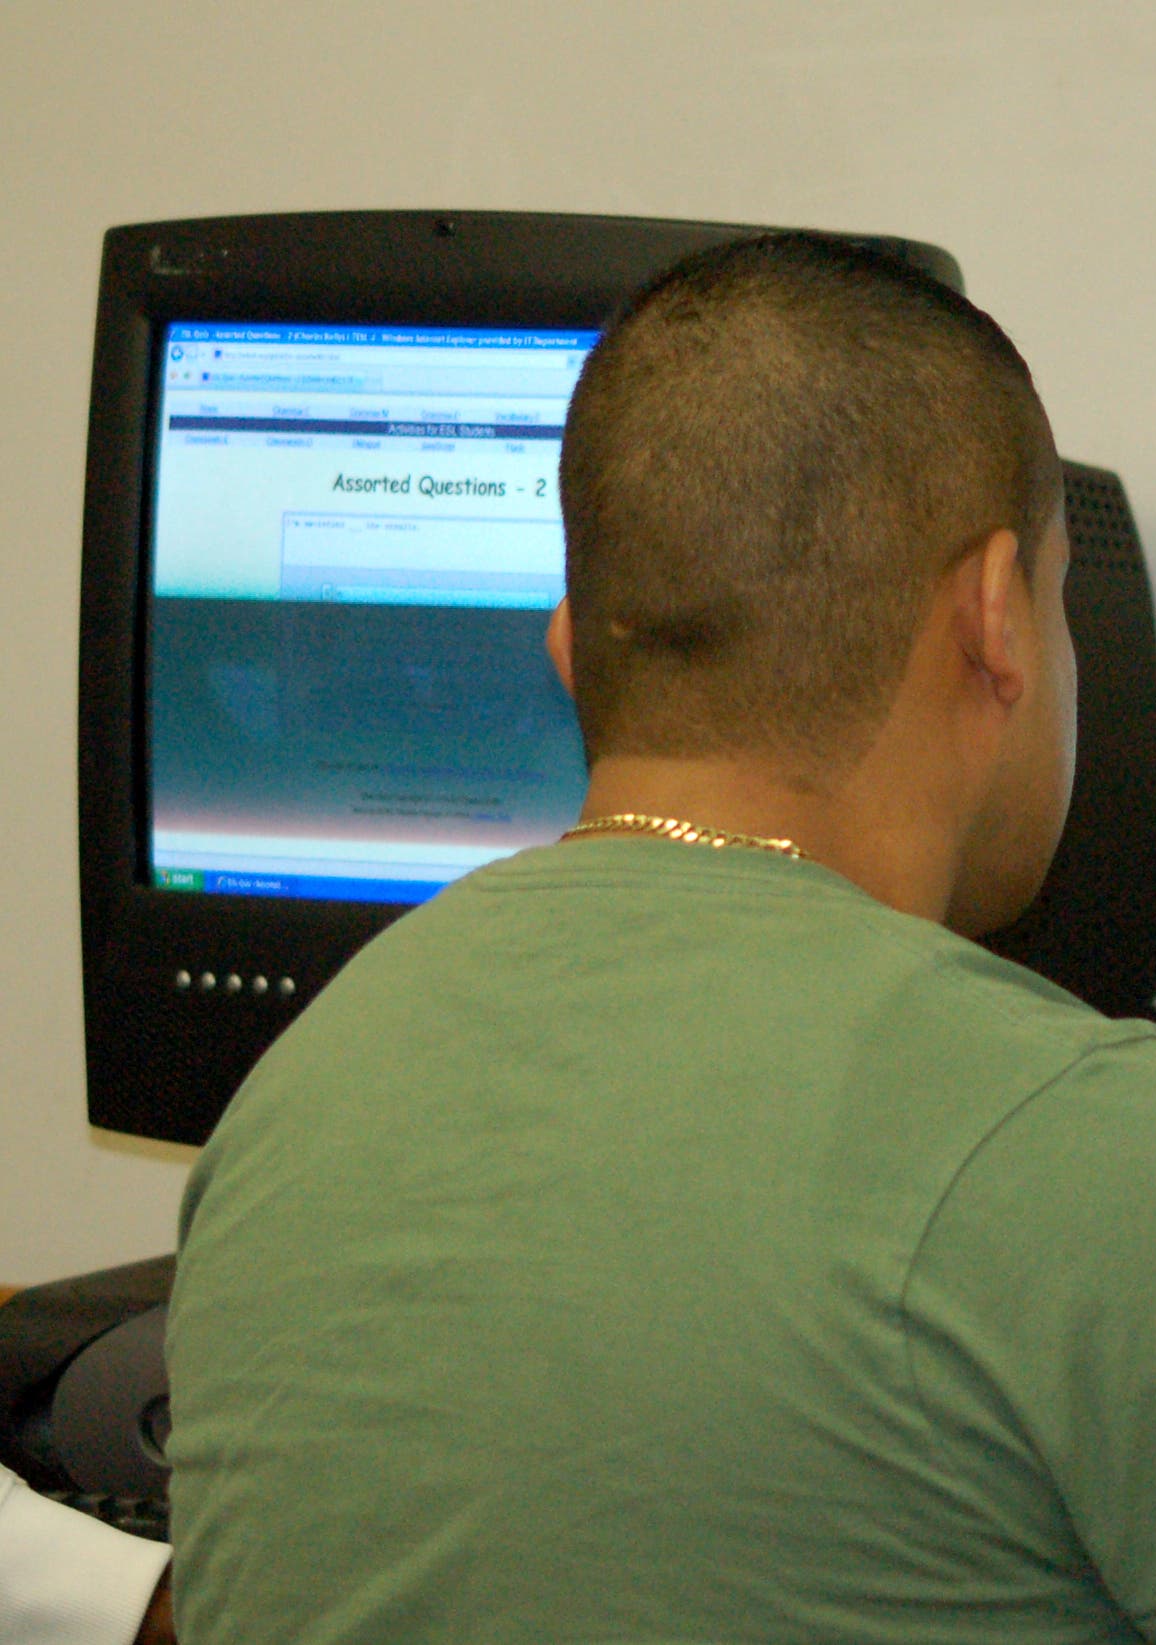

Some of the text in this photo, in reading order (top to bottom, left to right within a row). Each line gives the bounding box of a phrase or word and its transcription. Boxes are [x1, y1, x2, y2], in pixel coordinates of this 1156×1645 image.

[333, 473, 411, 494] Assorted
[418, 475, 506, 498] Questions
[535, 478, 547, 497] 2
[171, 873, 195, 885] start
